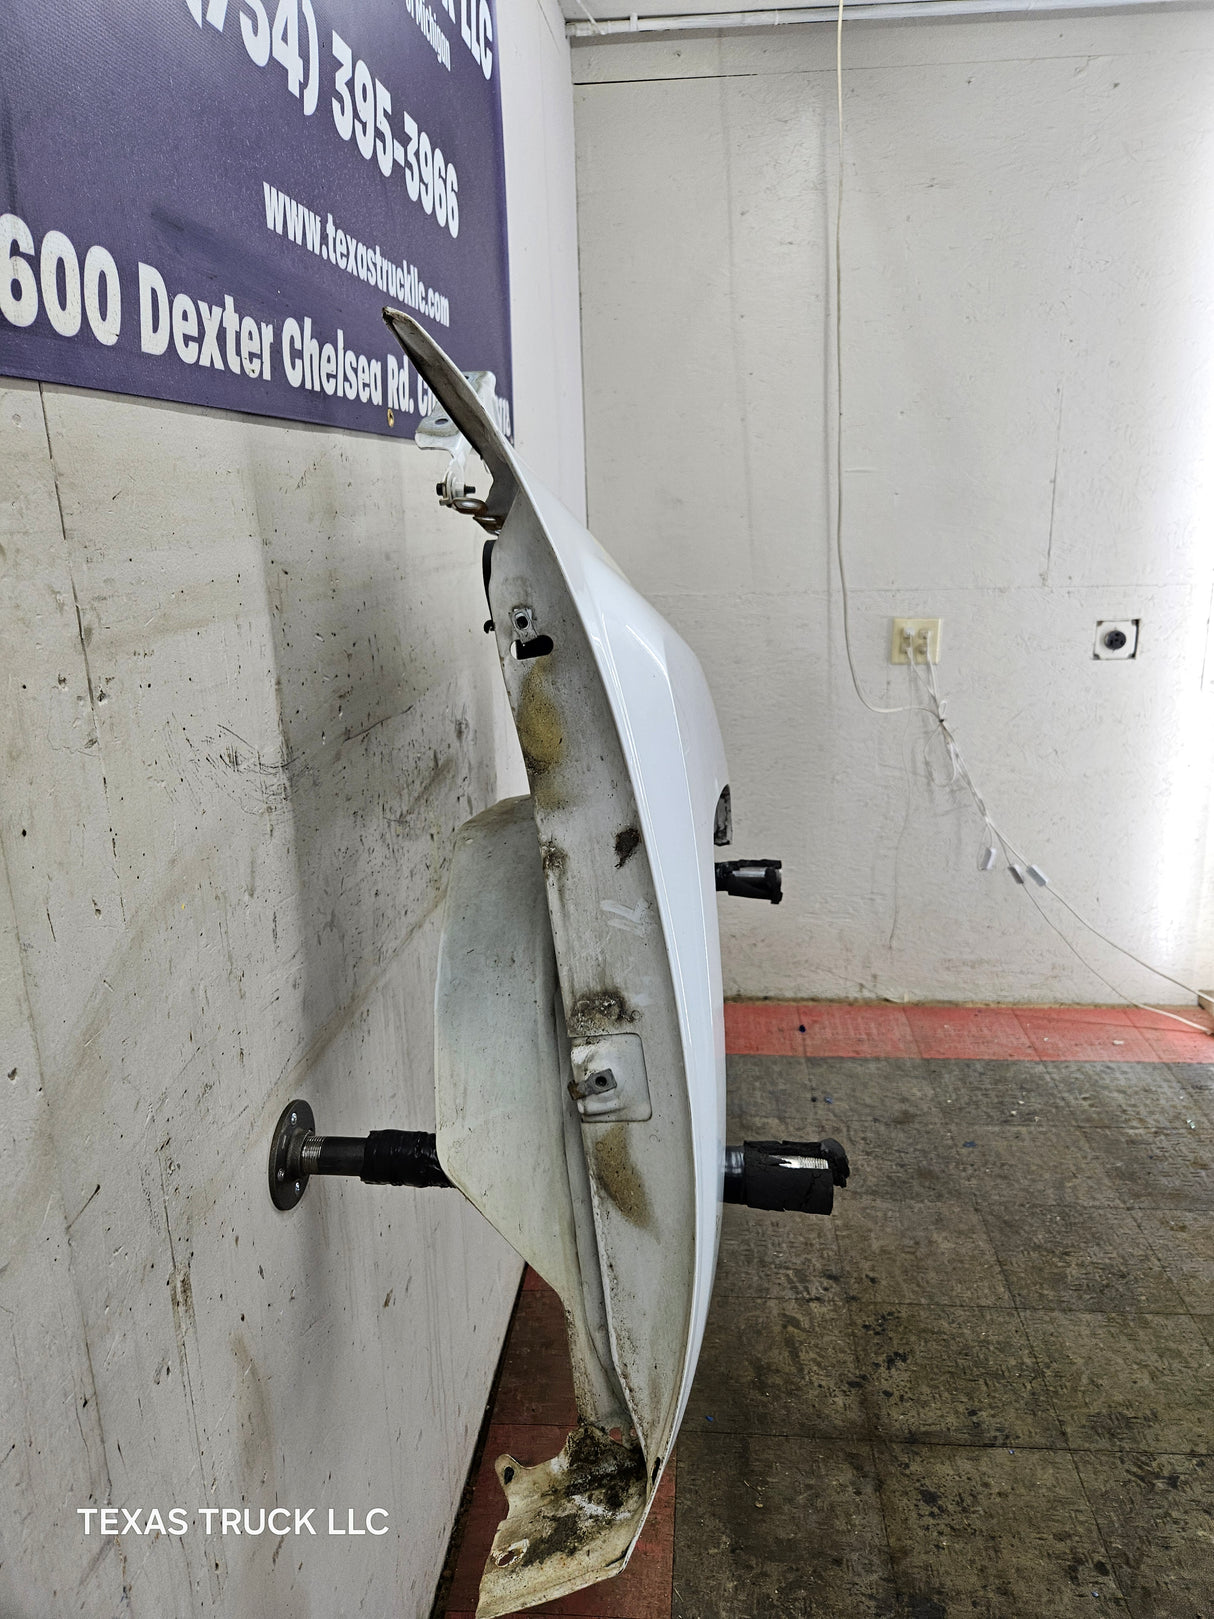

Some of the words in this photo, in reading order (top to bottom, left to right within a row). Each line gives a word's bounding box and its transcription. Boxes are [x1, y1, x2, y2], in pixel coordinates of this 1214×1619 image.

[331, 29, 460, 239] 395-3966
[262, 180, 450, 329] www.texastruckllc.com
[138, 262, 274, 381] Dexter
[282, 316, 383, 406] Chelsea
[387, 353, 415, 414] Rd.
